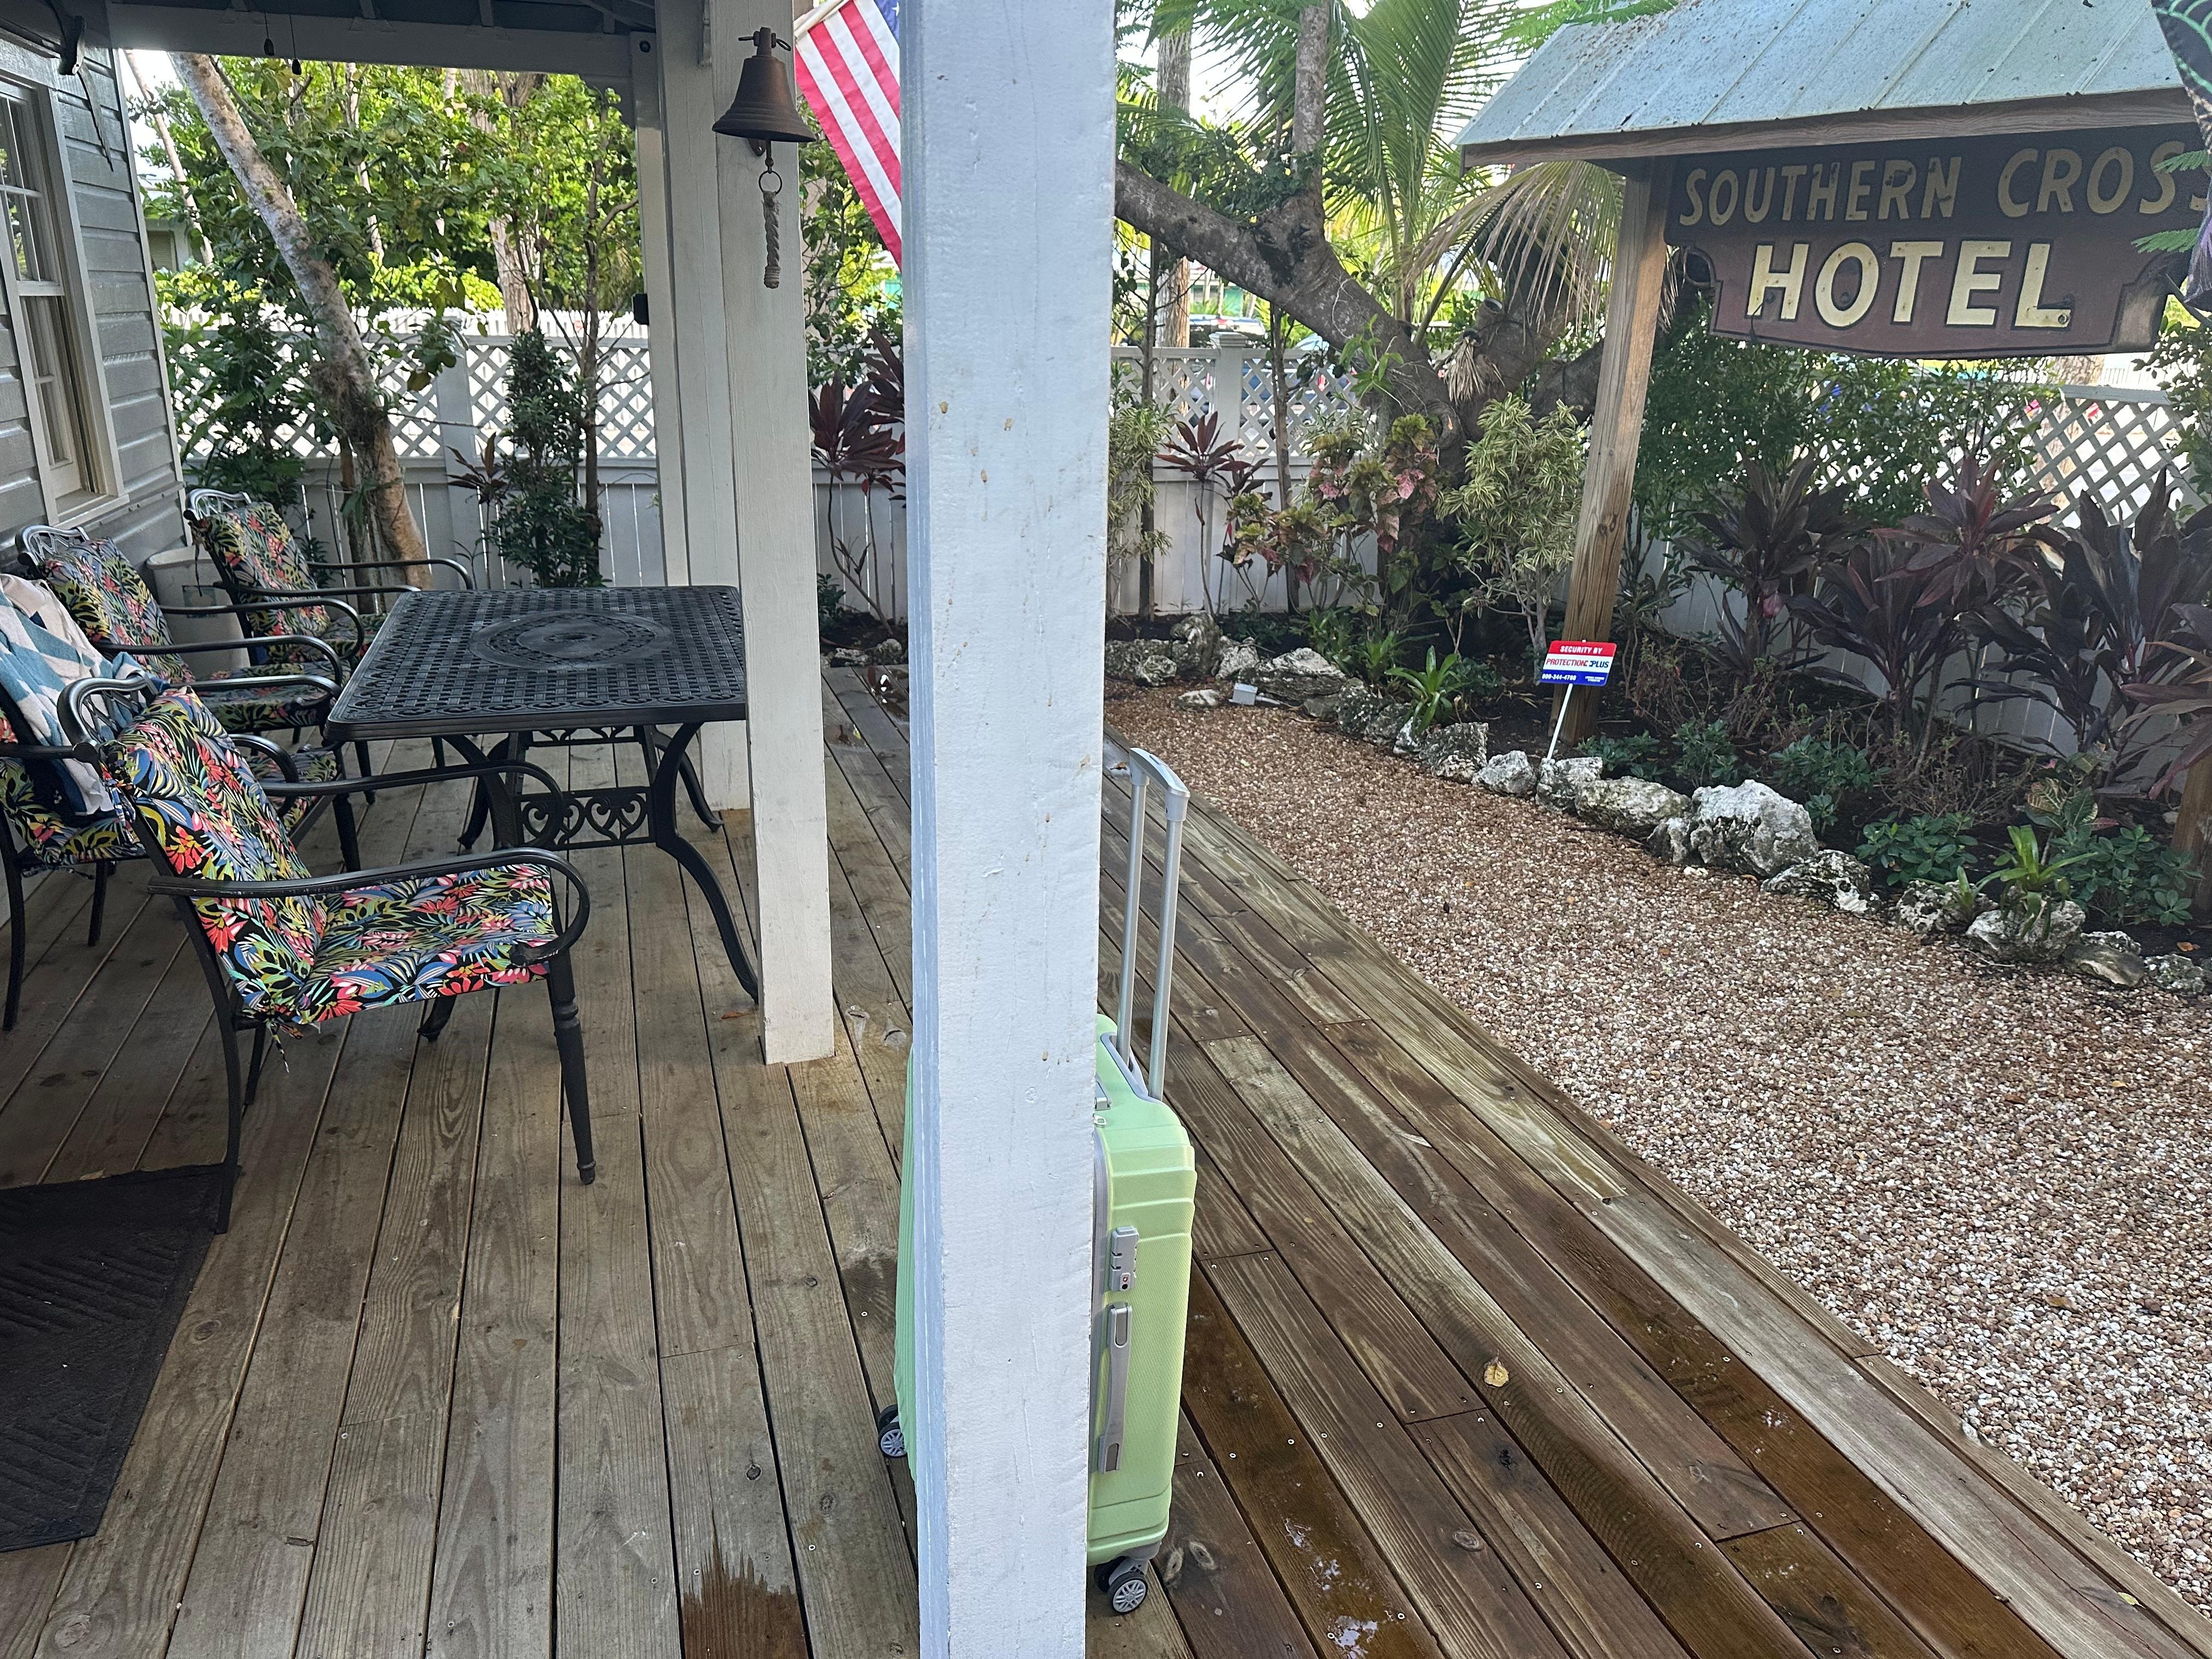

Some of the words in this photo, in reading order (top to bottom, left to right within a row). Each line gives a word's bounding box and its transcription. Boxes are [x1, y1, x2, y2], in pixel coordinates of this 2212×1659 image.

[1679, 157, 1962, 225] SOUTHERN
[1747, 241, 2071, 328] HOTEL
[1546, 658, 1585, 667] PROTECTION
[1560, 645, 1592, 654] SECURITY
